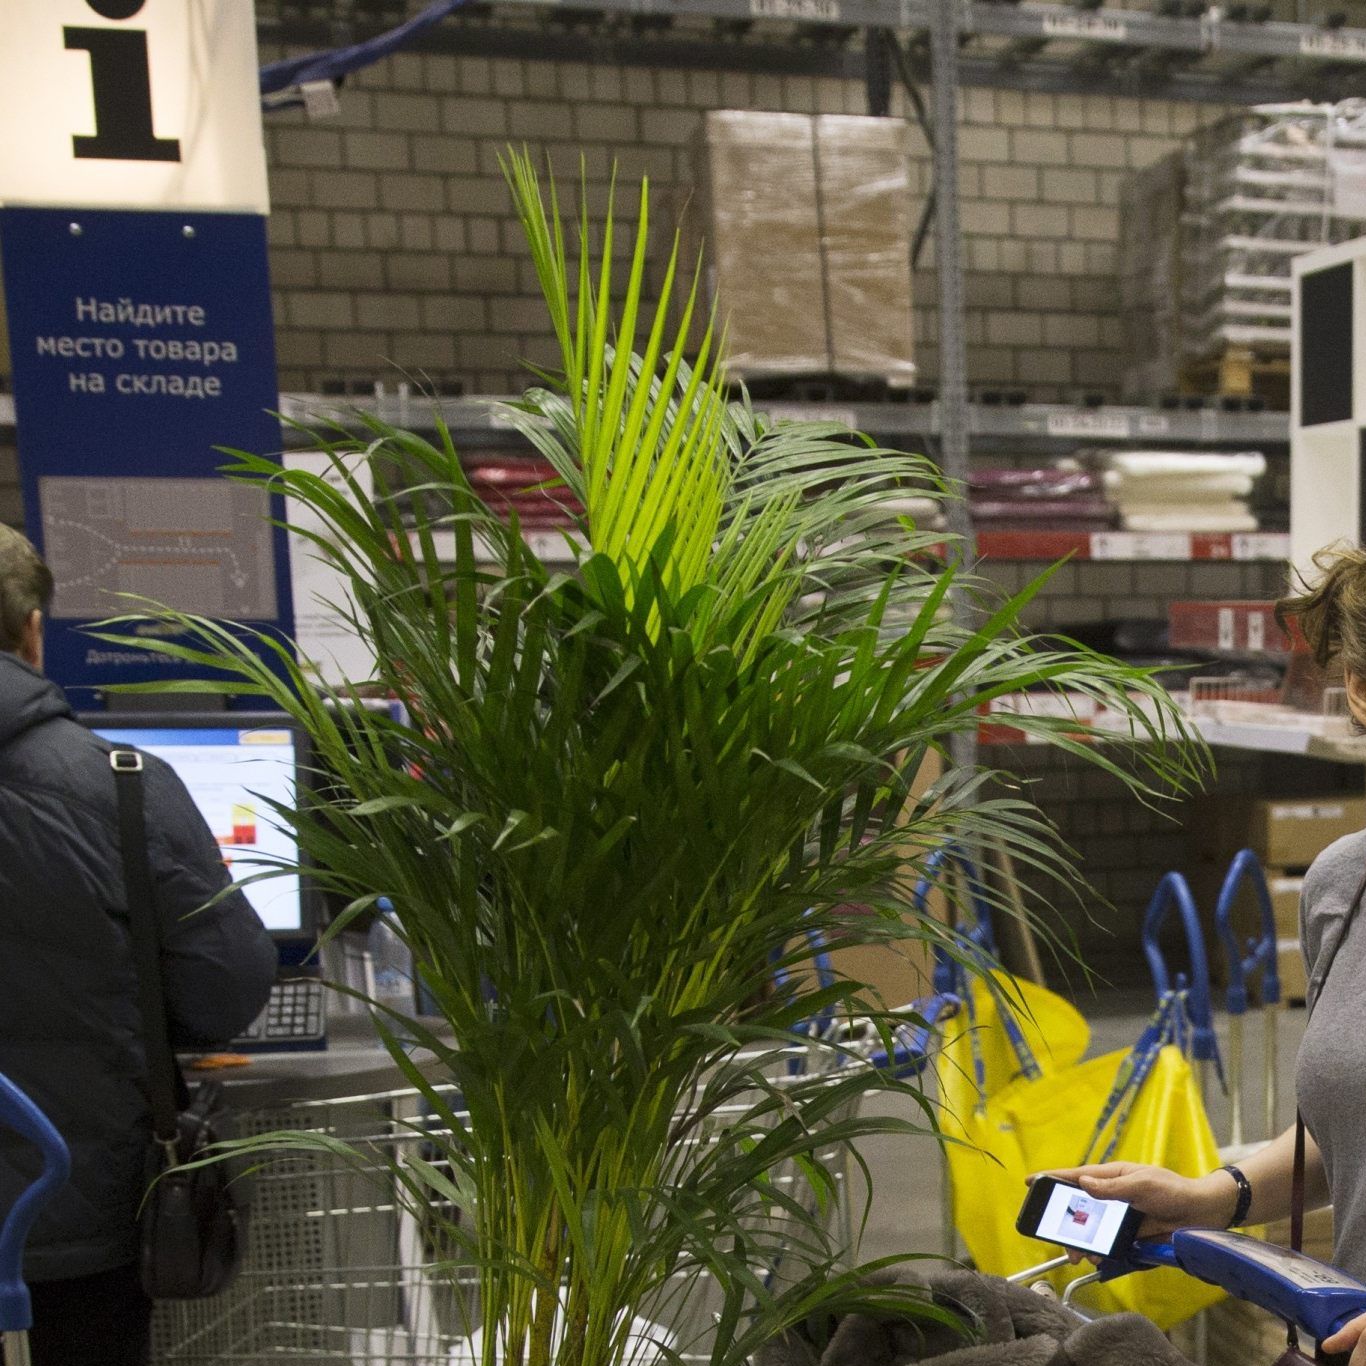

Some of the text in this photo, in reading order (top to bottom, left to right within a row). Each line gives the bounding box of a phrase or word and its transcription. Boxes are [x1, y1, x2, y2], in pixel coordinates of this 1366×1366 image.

[75, 296, 206, 328] Найдите
[35, 335, 239, 368] место товара
[68, 371, 223, 400] на складе
